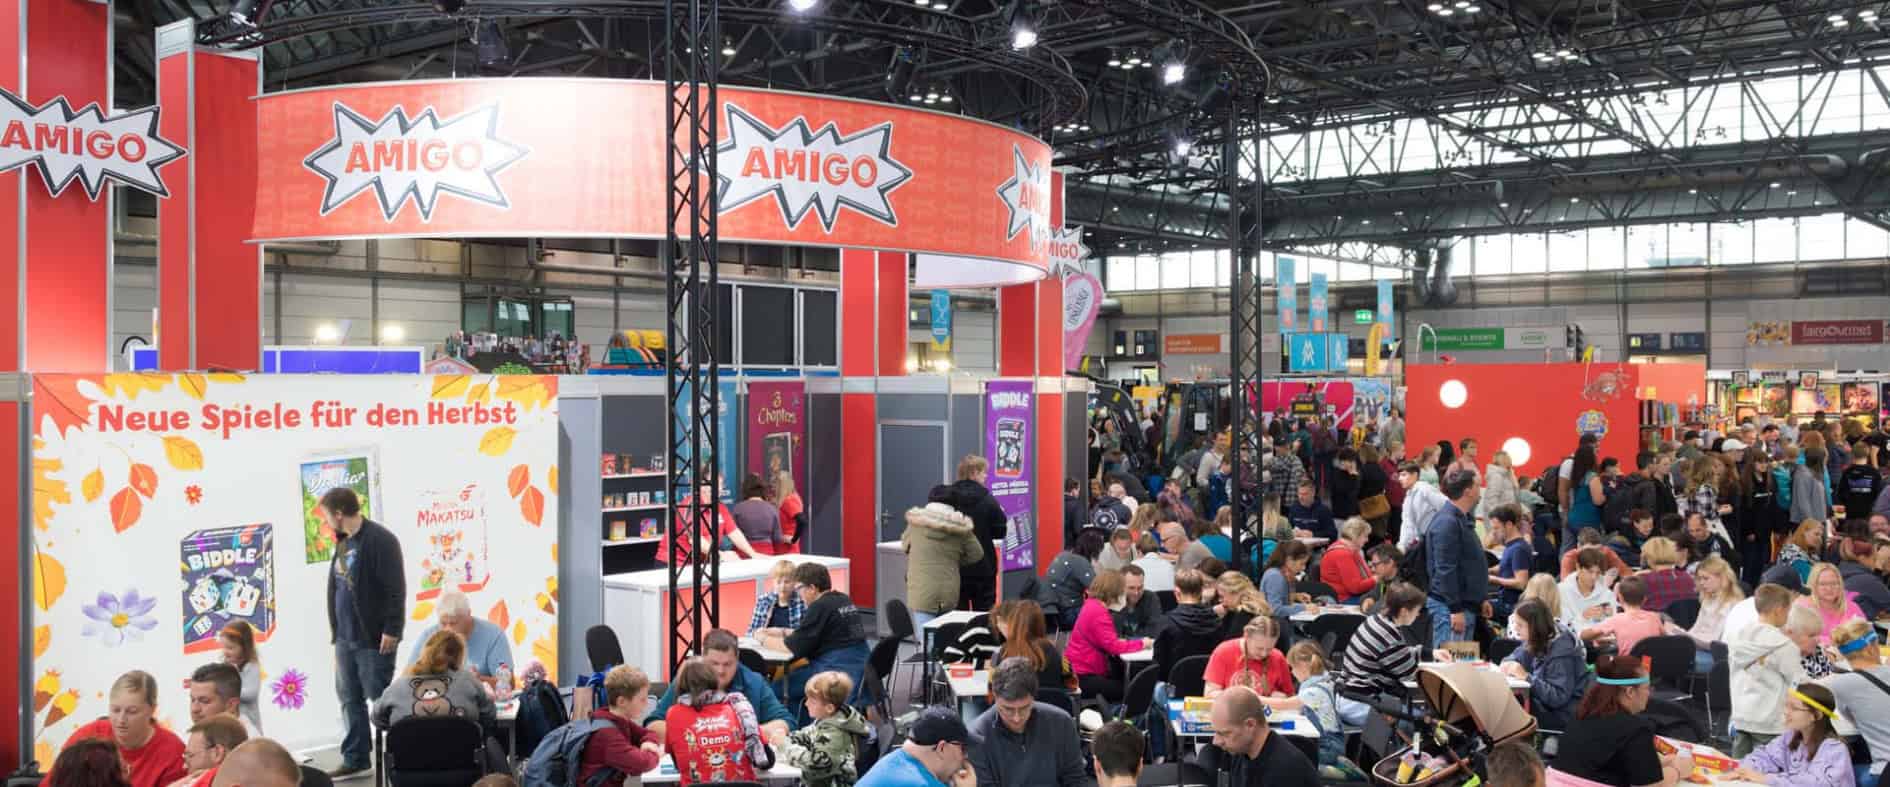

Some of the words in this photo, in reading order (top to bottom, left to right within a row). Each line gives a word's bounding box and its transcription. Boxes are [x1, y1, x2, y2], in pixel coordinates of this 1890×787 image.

[0, 119, 147, 162] AMIGO
[345, 140, 483, 173] AMIGO
[741, 147, 878, 188] AMIGO
[991, 391, 1029, 409] BIDDLE
[98, 404, 190, 432] Neue
[201, 402, 301, 440] Spiele
[310, 400, 357, 428] für
[366, 402, 419, 428] den
[427, 401, 517, 425] Herbst
[417, 509, 474, 528] MAKATSU
[188, 548, 257, 571] BIDDLE
[701, 735, 730, 746] Demo
